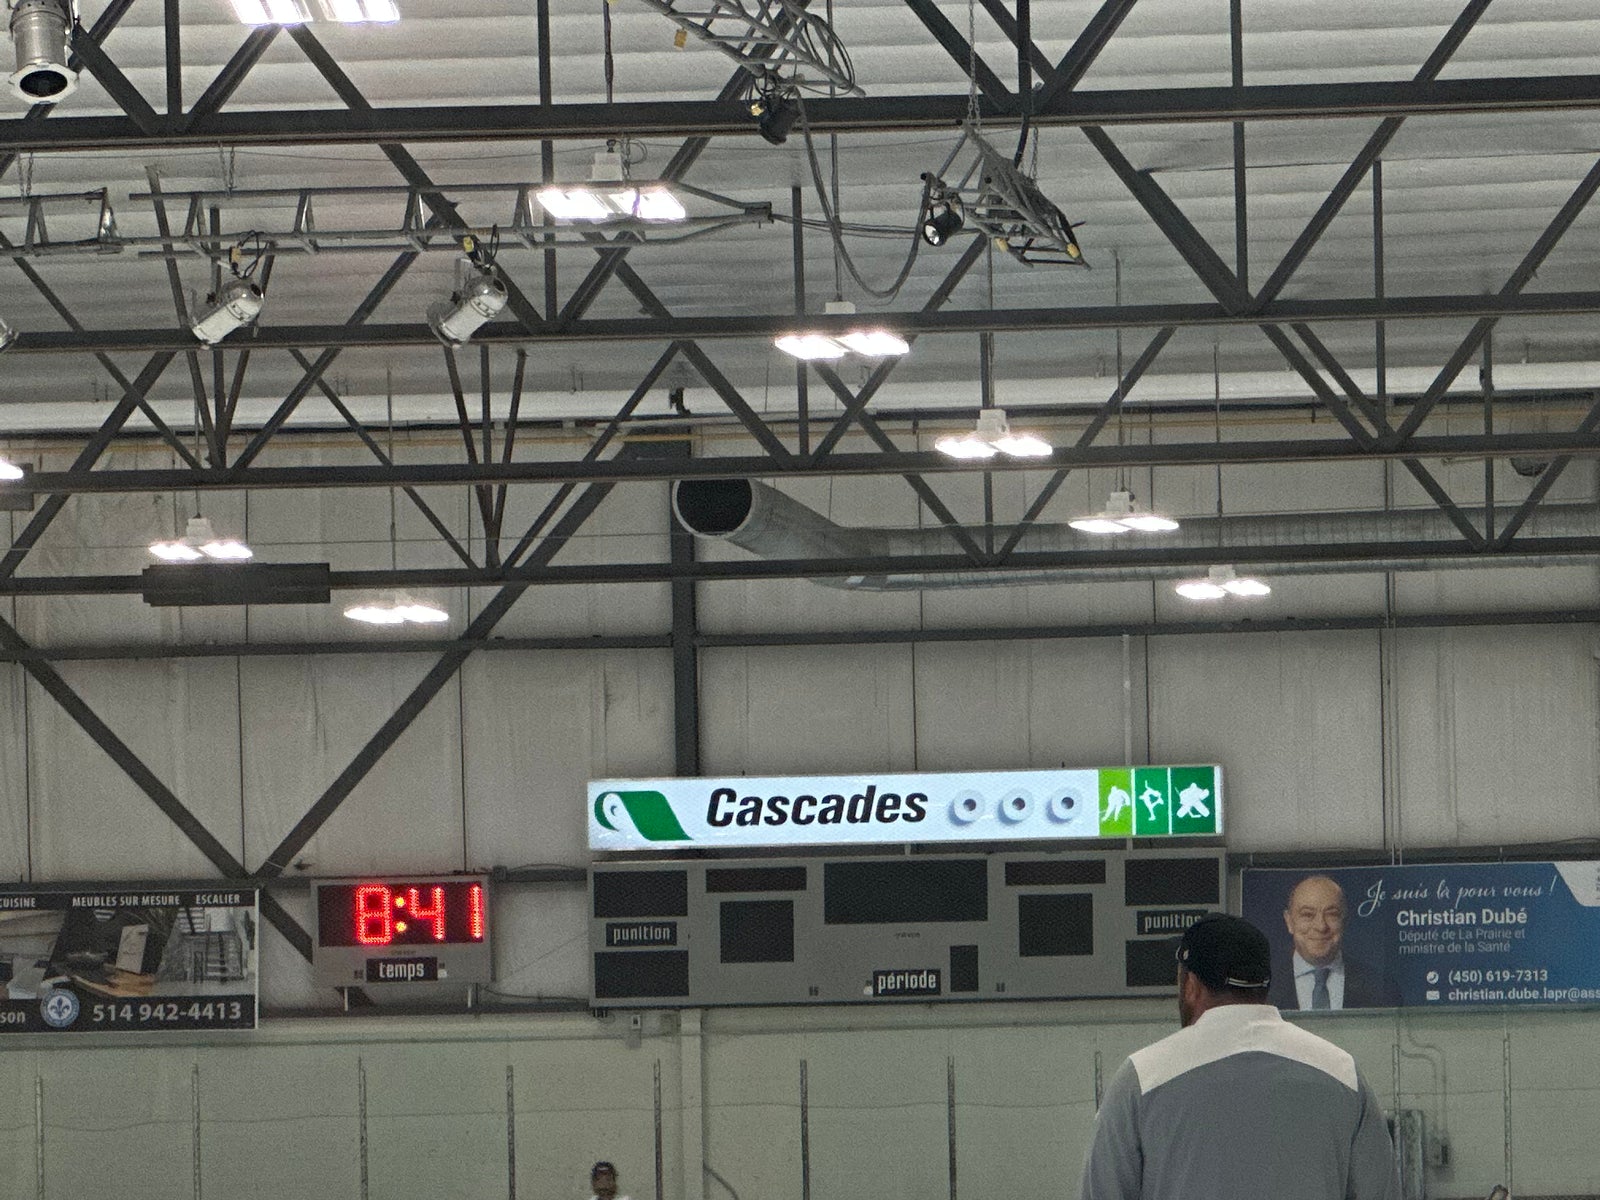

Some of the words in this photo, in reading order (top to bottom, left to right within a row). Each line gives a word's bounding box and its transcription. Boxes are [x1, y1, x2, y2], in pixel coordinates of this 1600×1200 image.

[706, 785, 928, 827] Cascades
[73, 897, 117, 908] MEUBLES
[120, 896, 139, 907] SUR
[142, 895, 181, 907] MESURE
[196, 893, 240, 904] ESCALIER
[1357, 880, 1386, 917] Je
[1391, 883, 1428, 900] suis
[1436, 880, 1451, 899] là
[1454, 886, 1496, 909] pour
[1503, 884, 1543, 898] vous
[357, 885, 483, 944] 8:41
[1397, 908, 1476, 926] Christian
[1482, 907, 1528, 925] Dubé
[613, 925, 671, 944] punition
[1399, 930, 1439, 944] Député
[1442, 929, 1456, 940] de
[1458, 928, 1473, 940] La
[1476, 927, 1512, 940] Prairie
[1515, 927, 1526, 939] et
[1399, 942, 1446, 955] ministre
[1448, 941, 1462, 954] de
[1464, 941, 1475, 953] la
[1477, 940, 1511, 953] Santé
[379, 961, 425, 981] temps
[1448, 970, 1483, 986] (450)
[1486, 969, 1548, 983] 619-7313
[878, 970, 937, 993] période
[93, 1004, 134, 1022] 514
[139, 1002, 242, 1022] 942-4413
